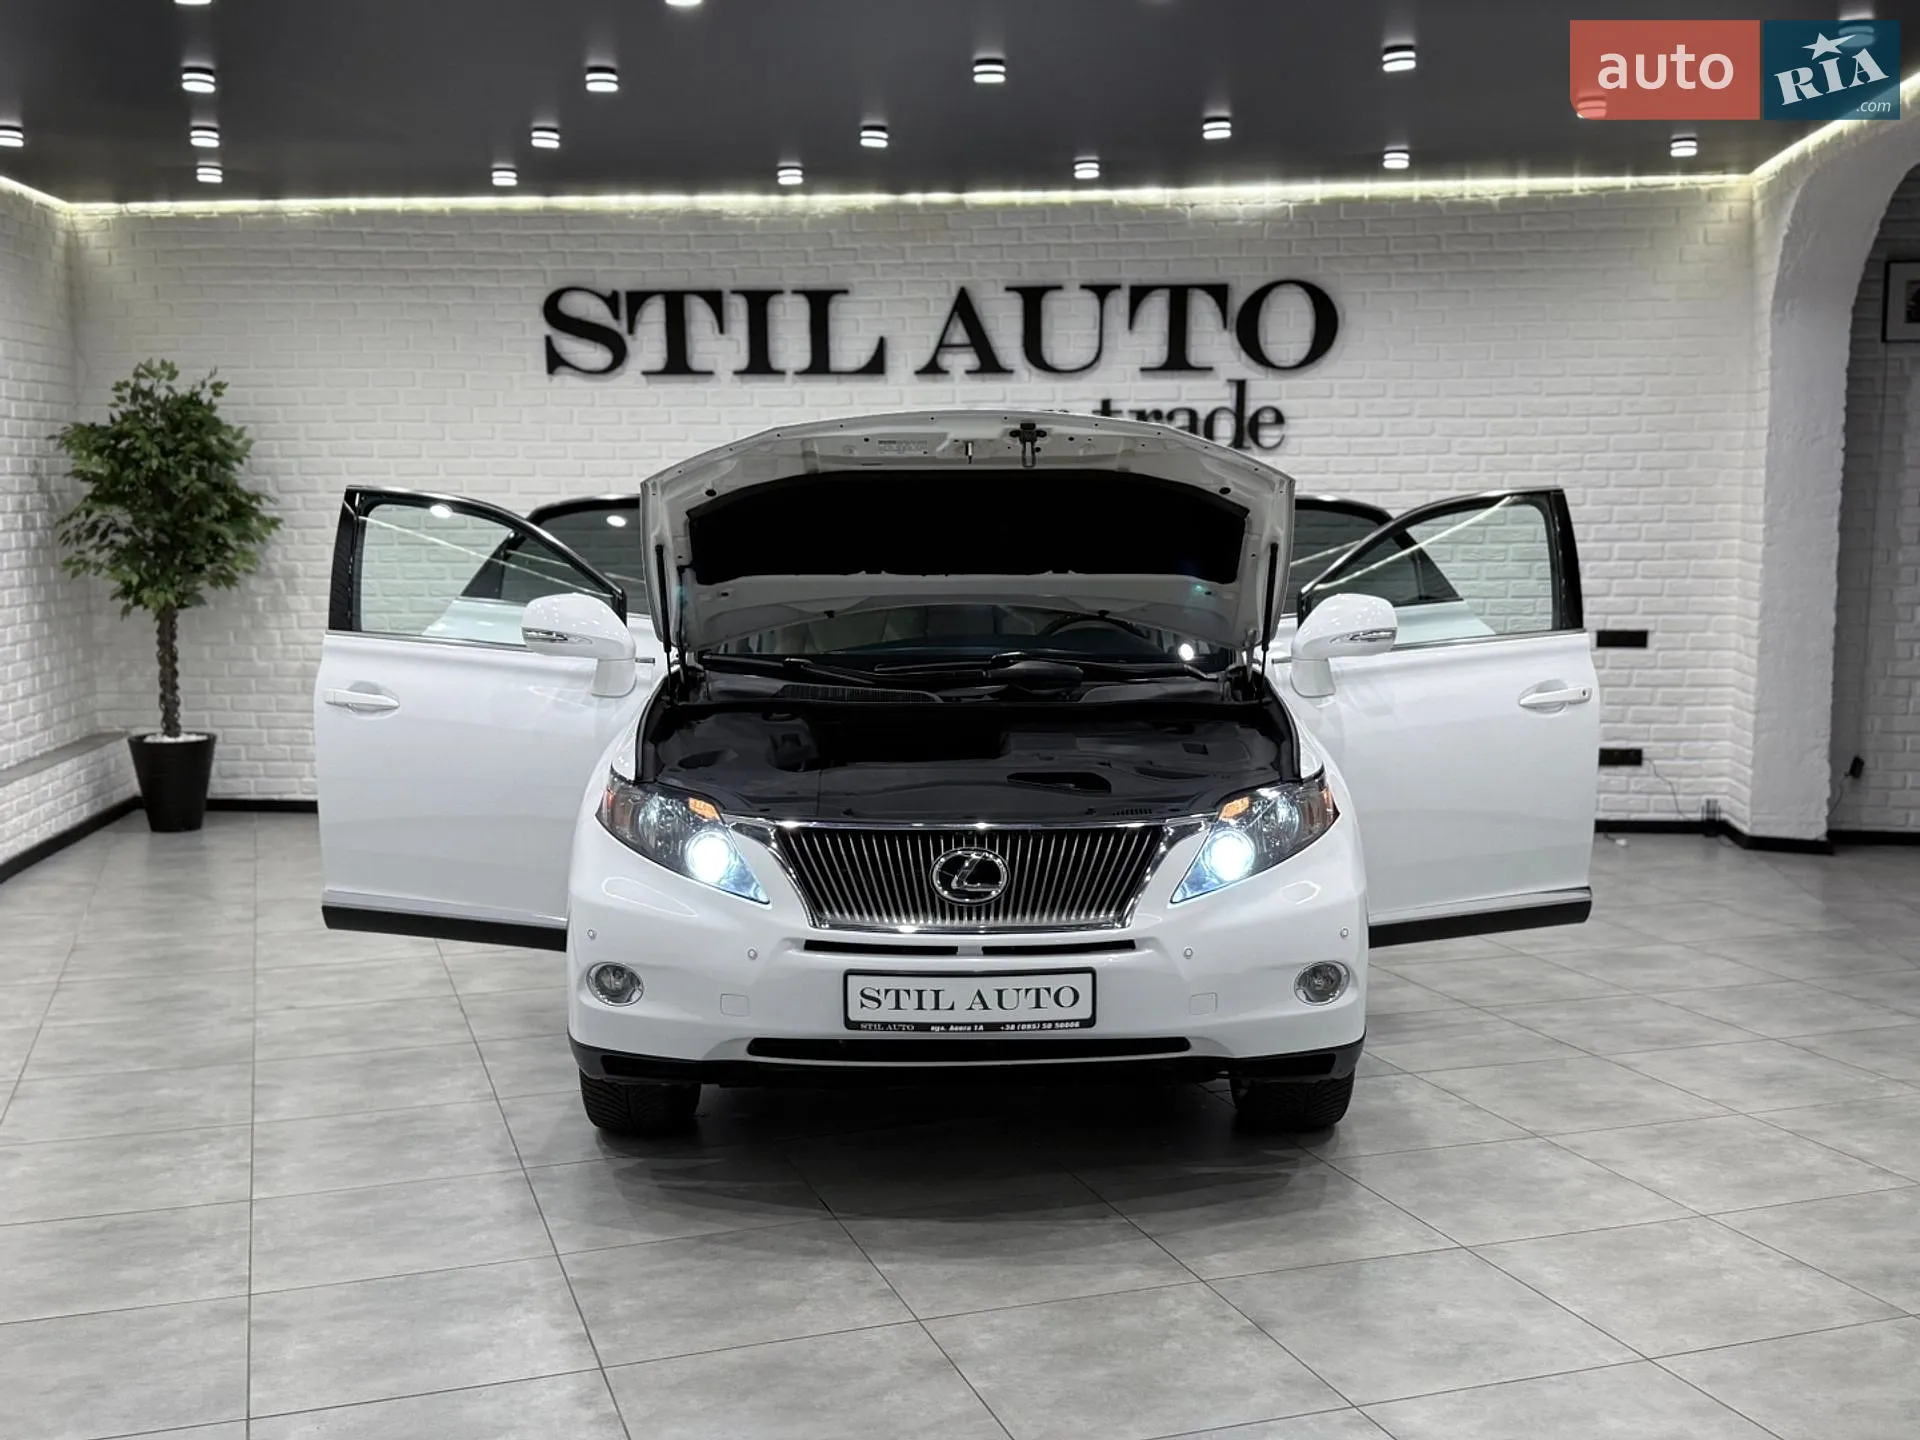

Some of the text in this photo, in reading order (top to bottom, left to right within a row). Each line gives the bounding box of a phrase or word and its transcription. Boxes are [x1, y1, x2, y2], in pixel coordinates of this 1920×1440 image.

[543, 279, 1338, 375] STIL AUTO
[860, 986, 1080, 1010] STIL AUTO
[860, 1023, 915, 1031] STIL AUTO
